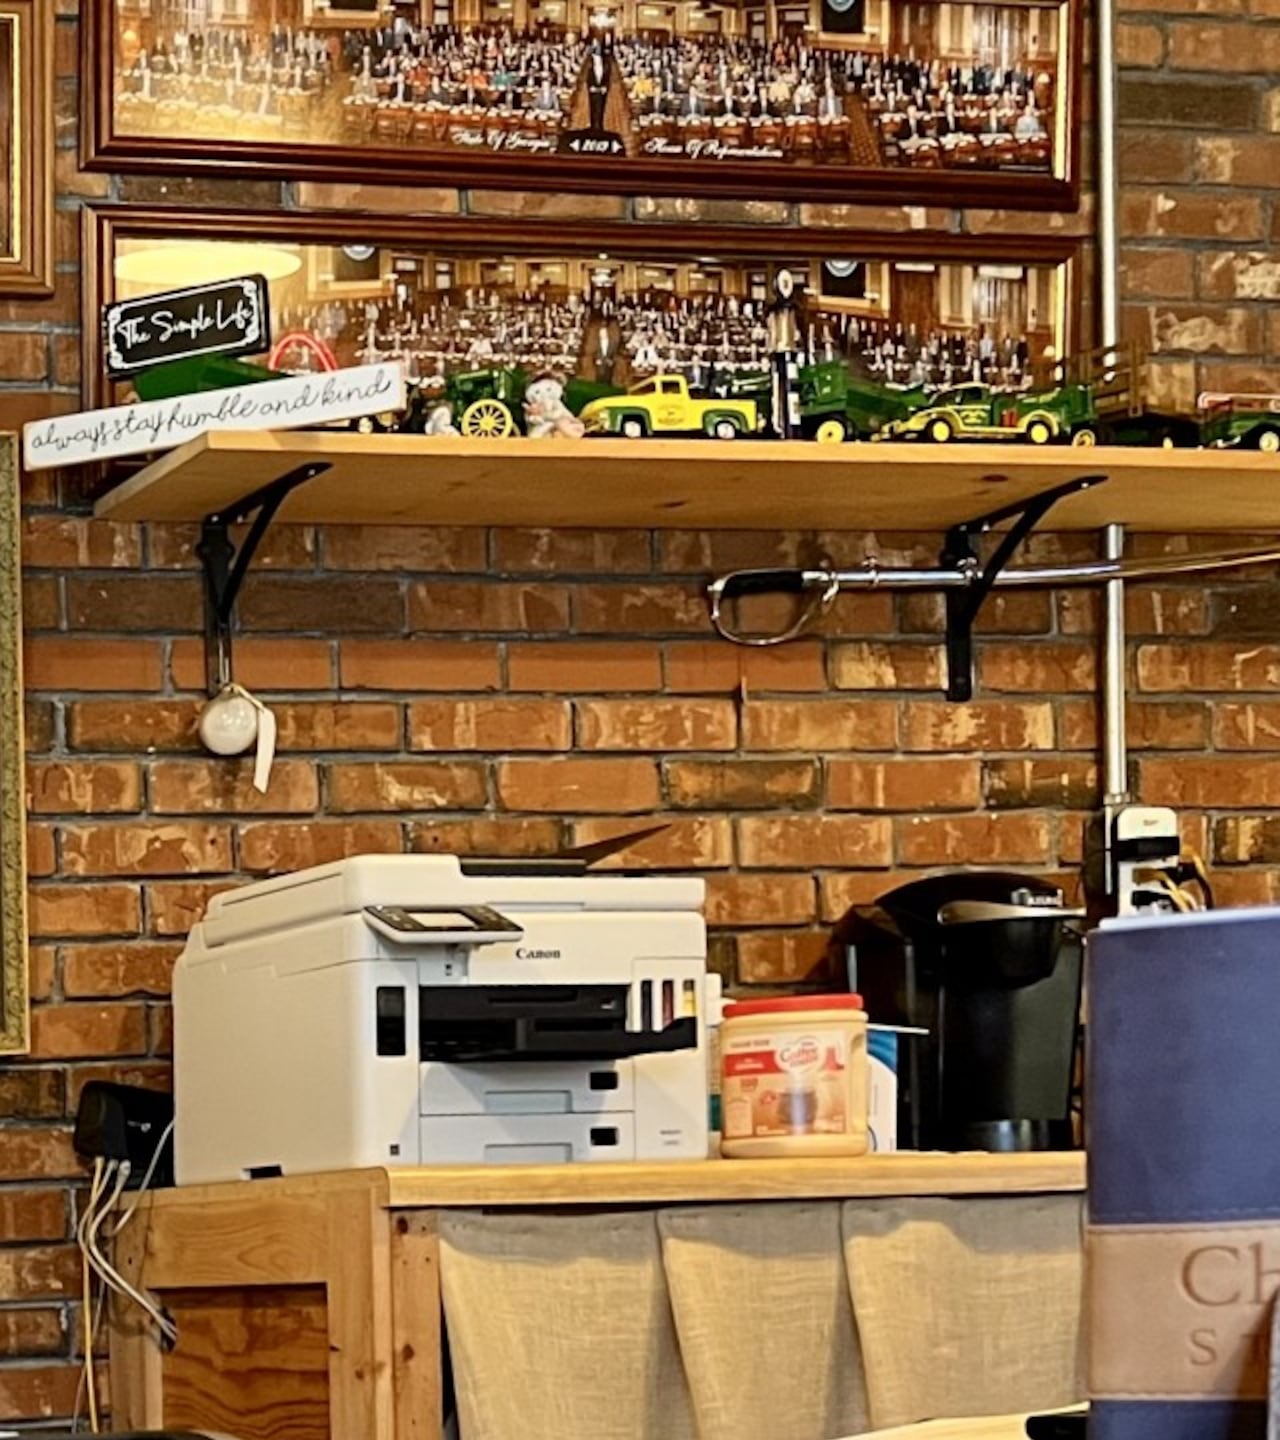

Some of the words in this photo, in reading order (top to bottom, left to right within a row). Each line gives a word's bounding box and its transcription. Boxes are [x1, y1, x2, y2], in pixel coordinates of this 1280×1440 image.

[116, 318, 151, 349] The
[150, 304, 215, 343] Simple
[215, 298, 254, 332] Life
[31, 422, 108, 453] always
[112, 405, 164, 444] stay
[163, 394, 258, 433] humble
[259, 387, 319, 416] and
[321, 369, 392, 406] kind
[515, 947, 561, 960] Canon
